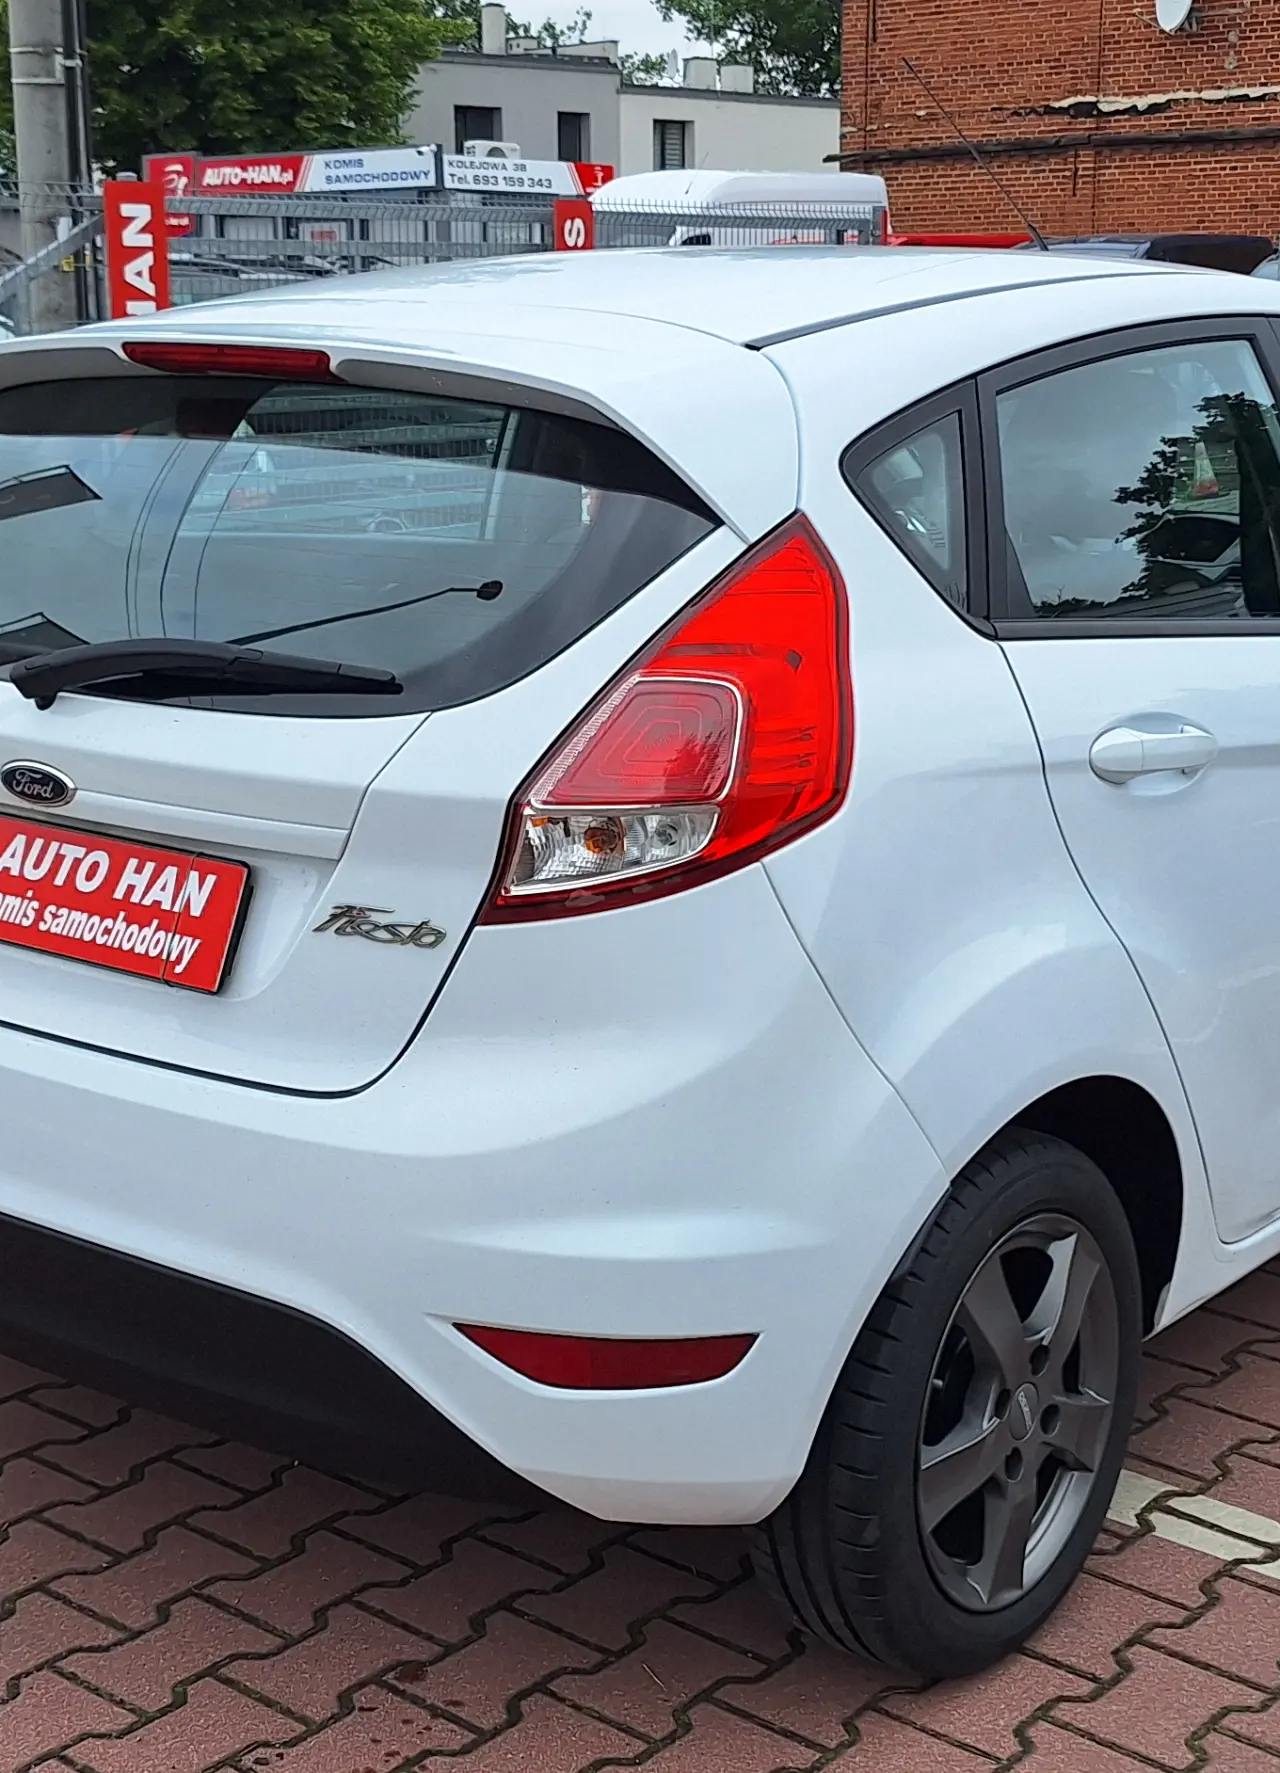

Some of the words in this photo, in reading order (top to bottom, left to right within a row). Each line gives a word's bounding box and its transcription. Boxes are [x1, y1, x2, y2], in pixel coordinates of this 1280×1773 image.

[202, 164, 293, 186] AUTO-HAN.pl
[324, 159, 364, 170] KOMIS
[448, 160, 508, 171] KOLEJOWA
[325, 170, 431, 184] SAMOCHODOWY
[449, 174, 469, 185] Tel.
[473, 174, 499, 186] 693
[503, 176, 525, 188] 159
[528, 178, 552, 189] 343
[12, 769, 54, 799] Ford
[113, 857, 217, 918] HAN
[312, 904, 447, 949] Fiesta
[38, 904, 202, 974] samochodowy
